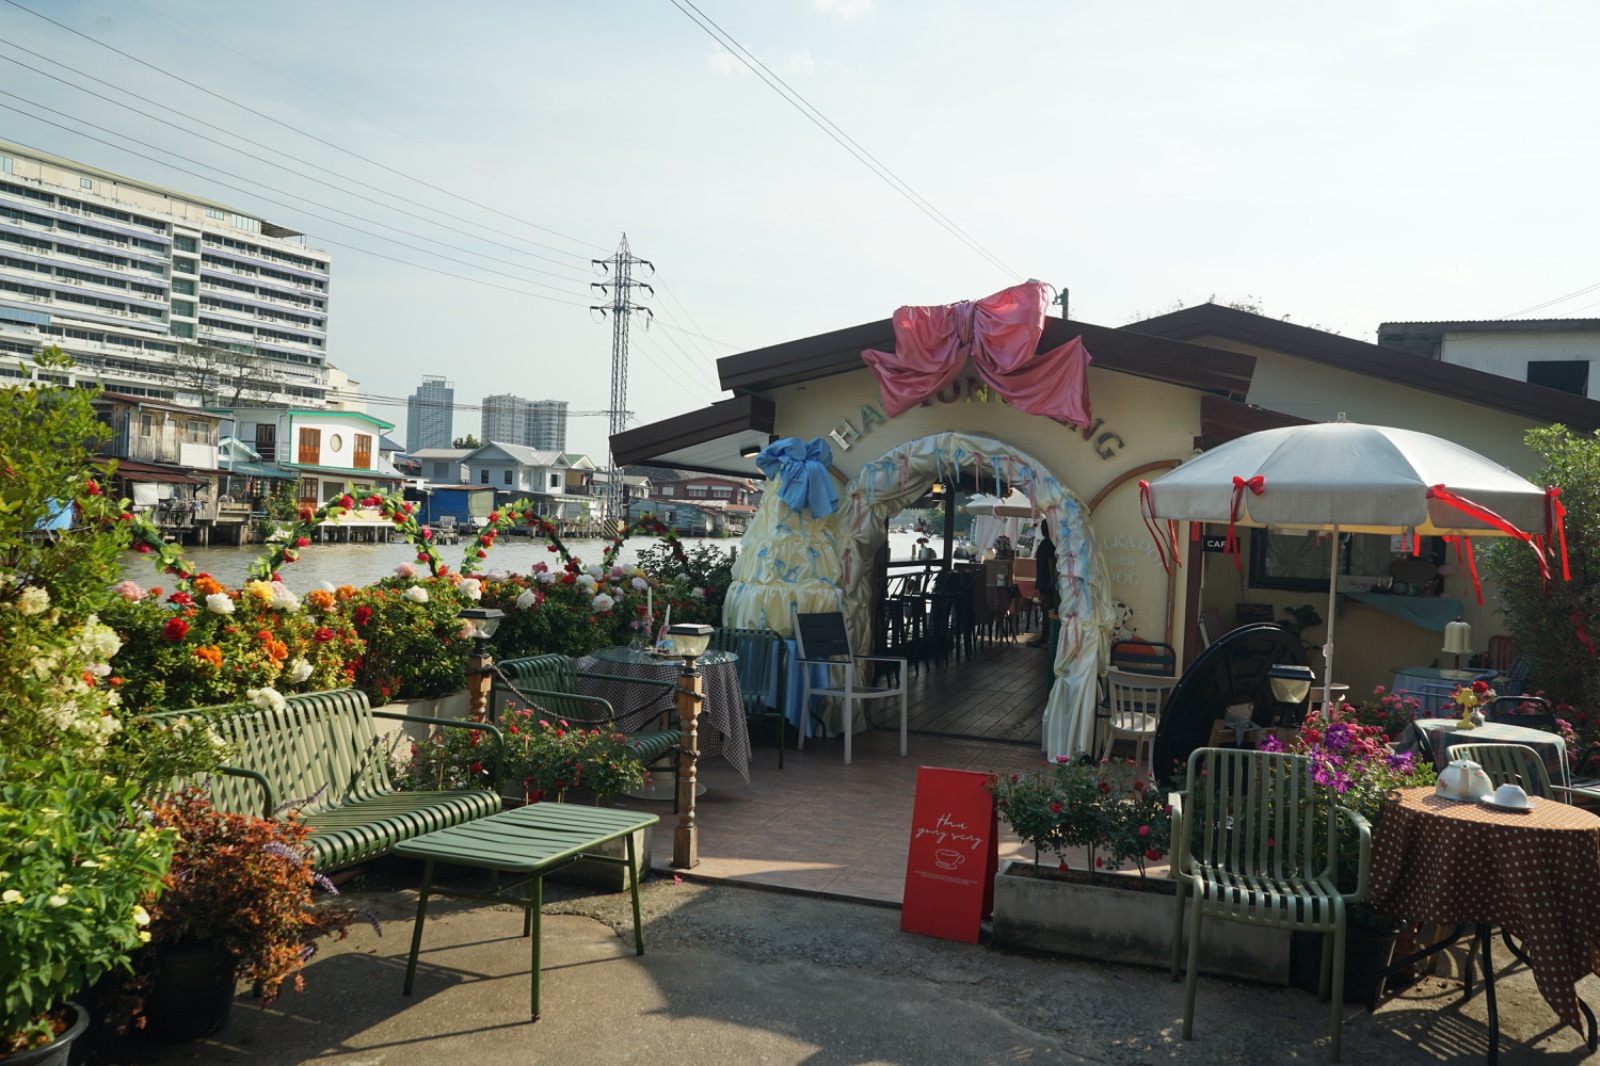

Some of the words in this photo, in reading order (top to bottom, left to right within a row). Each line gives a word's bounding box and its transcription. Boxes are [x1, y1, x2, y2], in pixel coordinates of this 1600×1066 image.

[828, 394, 888, 452] HA
[920, 377, 1011, 407] ON
[1207, 539, 1227, 548] CAF
